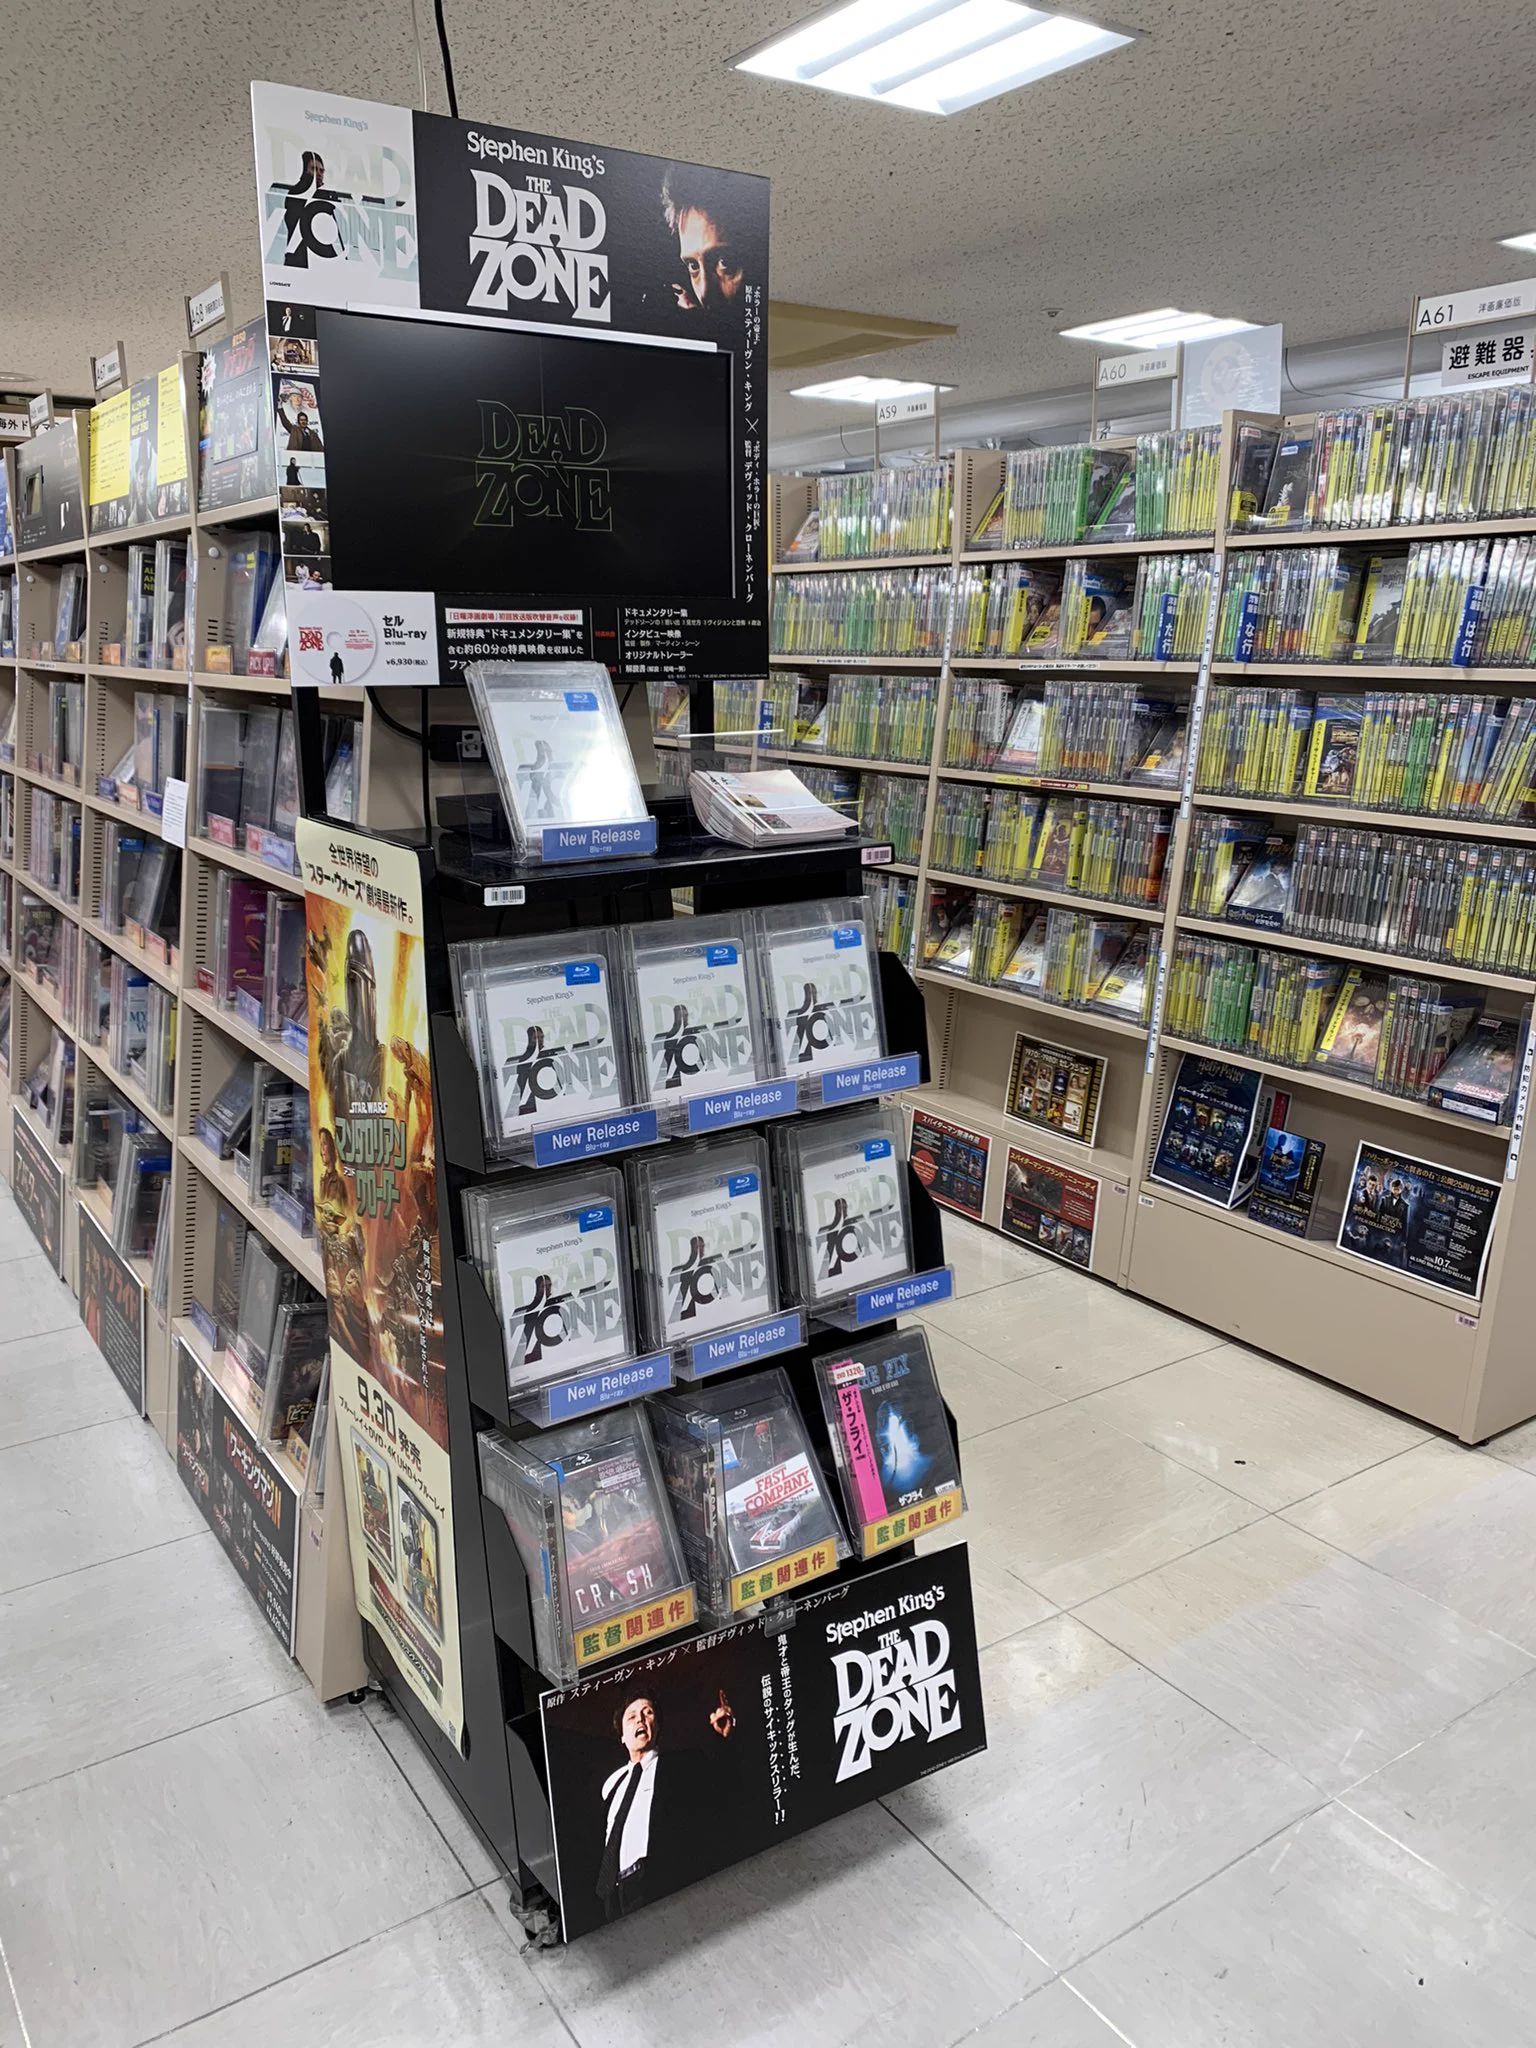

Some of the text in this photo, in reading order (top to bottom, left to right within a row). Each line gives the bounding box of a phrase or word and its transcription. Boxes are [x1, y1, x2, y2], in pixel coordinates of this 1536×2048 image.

[467, 131, 606, 179] Stephen King's
[525, 175, 551, 193] THE
[469, 168, 607, 252] DEAD
[466, 236, 612, 323] ZONE
[1419, 304, 1454, 327] A61
[744, 308, 753, 412] スティーヴン・キング
[1448, 335, 1535, 371] 避難器
[1100, 363, 1127, 382] A60
[1468, 365, 1529, 380] ESCAPE EQUIPMENT
[878, 405, 897, 420] A59
[476, 399, 607, 465] DEAD
[474, 461, 612, 532] ZONE
[744, 461, 754, 603] デヴィッド・クローネンバーグ
[382, 615, 404, 627] セル
[624, 608, 688, 617] ドキュメンタリー集
[383, 627, 427, 640] Blu-ray
[447, 643, 584, 655] 含む約60分の特典映像を収録した
[624, 629, 682, 638] インタビュー映像
[1161, 622, 1173, 654] た行
[1242, 621, 1256, 655] な行
[1460, 620, 1477, 658] は行
[624, 651, 693, 660] オリジナルトレーラー
[559, 826, 640, 848] New Release
[526, 990, 575, 1005] Stephen King's
[836, 1063, 906, 1088] New Release
[349, 1101, 388, 1114] STAR WARS
[705, 1088, 781, 1115] New Release
[552, 1120, 640, 1150] New Release
[585, 1141, 610, 1151] Blu-ray
[535, 1237, 583, 1255] Stephen King's
[870, 1279, 939, 1309] New Release
[709, 1325, 786, 1358] New Release
[567, 1365, 654, 1402] New Release
[841, 1390, 866, 1456] ザ・フライ
[398, 1427, 422, 1473] 発売
[230, 1431, 274, 1508] ワーキングマン
[756, 1466, 787, 1493] FAST
[745, 1469, 809, 1512] COMPANY
[877, 1500, 952, 1545] 監督関連作
[740, 1550, 826, 1601] 監督関連作
[582, 1599, 686, 1657] 監督関連作
[826, 1584, 946, 1645] Stephen King's
[877, 1629, 901, 1650] THE
[546, 1693, 565, 1709] 原作
[570, 1649, 677, 1700] スティーヴン・キング
[830, 1619, 950, 1717] DEAD
[777, 1633, 801, 1779] 鬼才と帝王のタッグが生んだ、
[833, 1669, 961, 1785] ZONE
